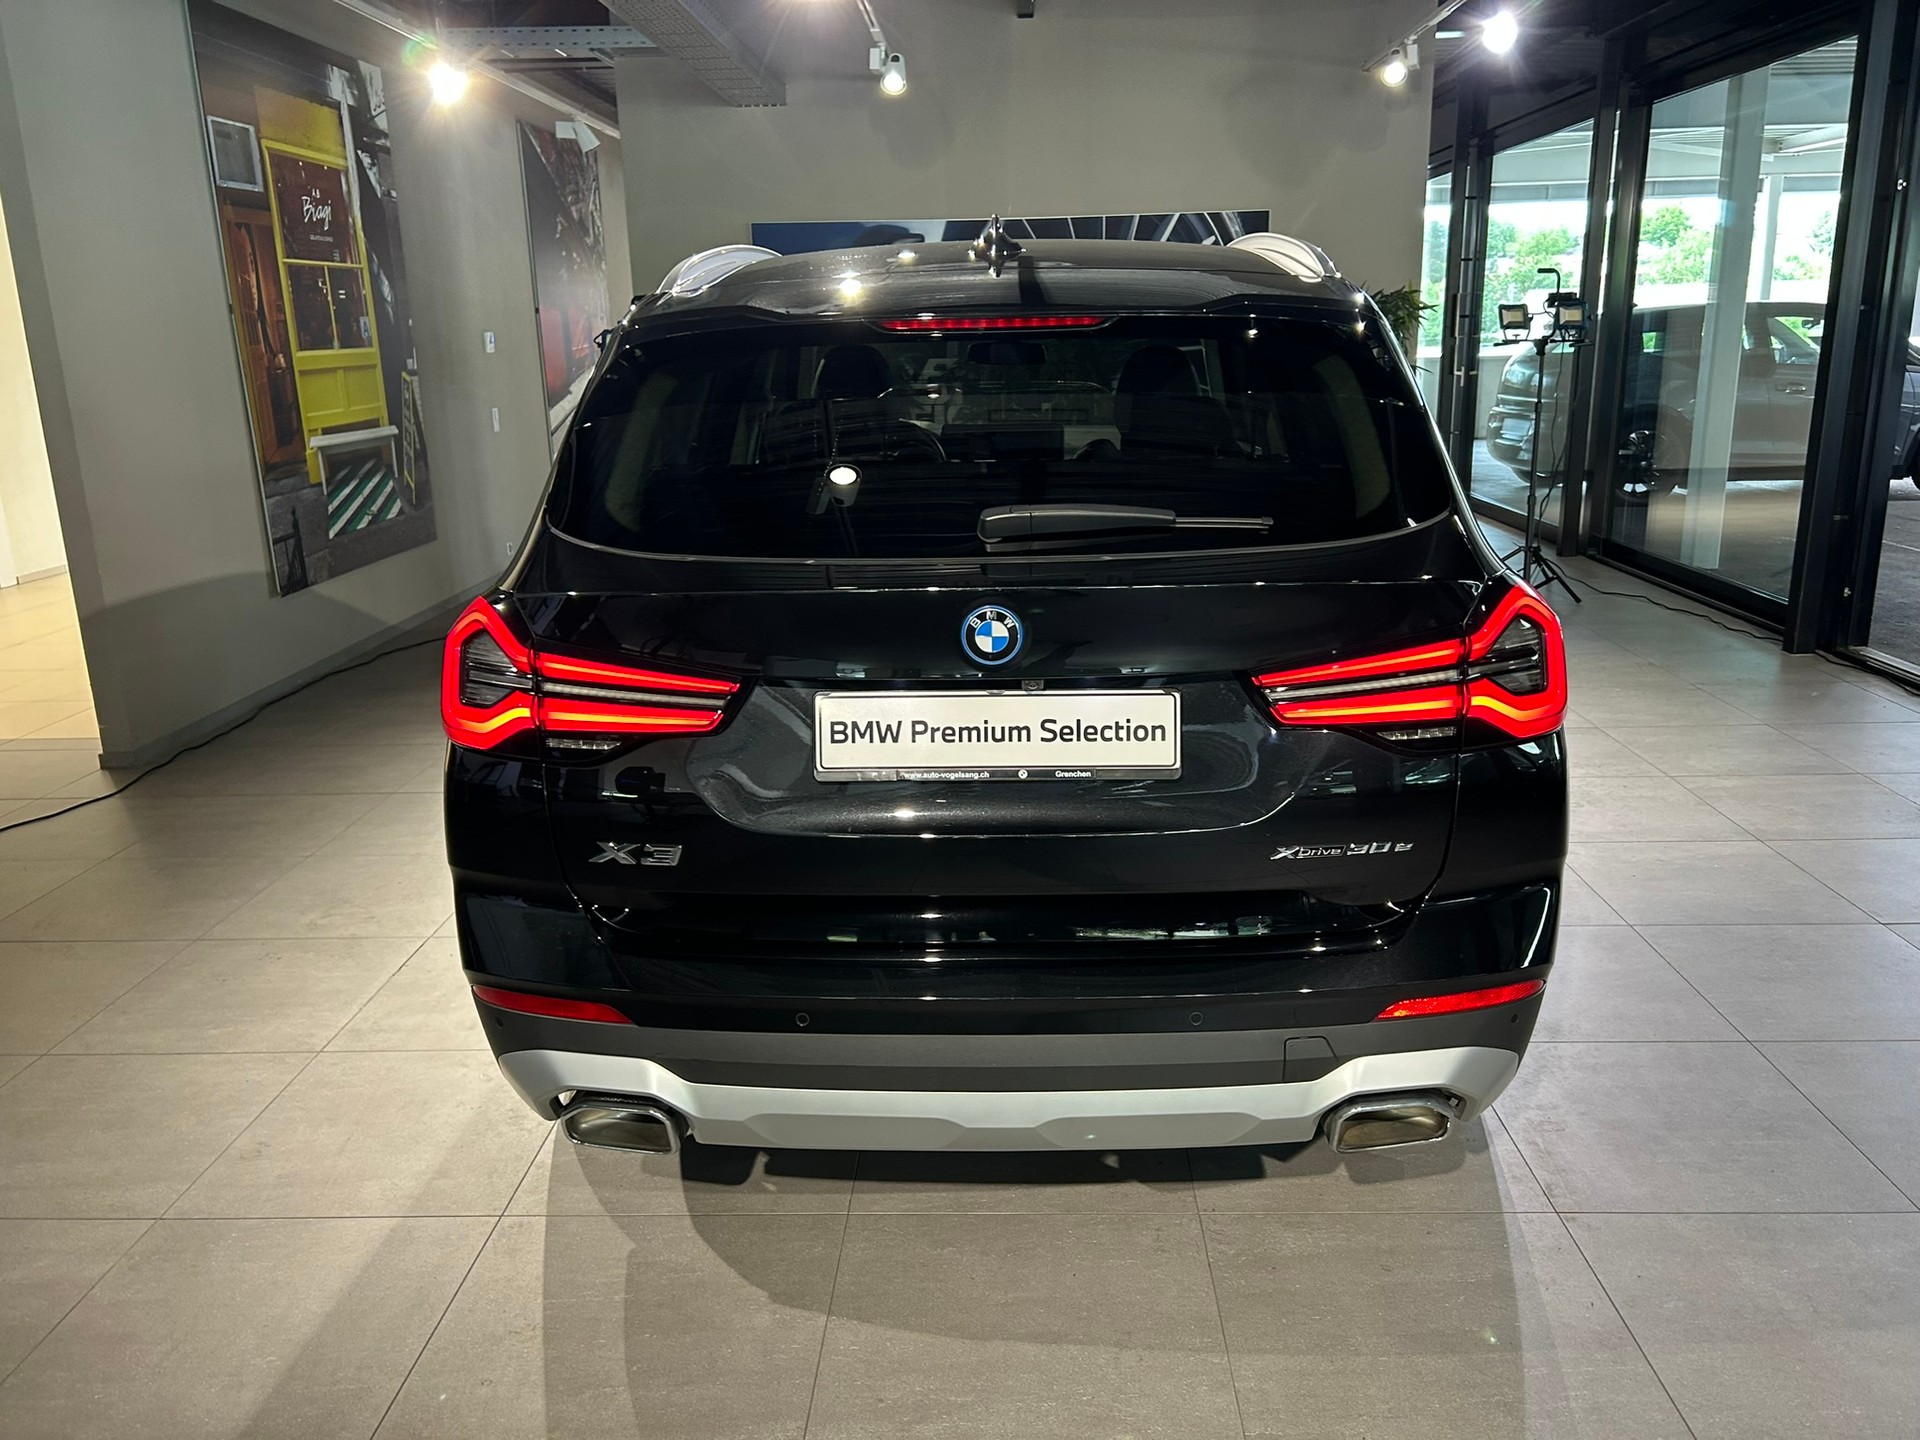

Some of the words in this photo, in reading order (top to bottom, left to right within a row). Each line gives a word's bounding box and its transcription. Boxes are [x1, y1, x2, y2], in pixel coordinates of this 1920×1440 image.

[301, 196, 332, 231] Biagi
[970, 610, 1015, 629] BMW
[830, 720, 902, 743] BMW
[911, 719, 1031, 743] Premium
[1040, 718, 1166, 742] Selection
[903, 771, 990, 780] www.auto-vogelsang.ch
[1055, 769, 1091, 778] Grenchen
[588, 841, 682, 866] X3
